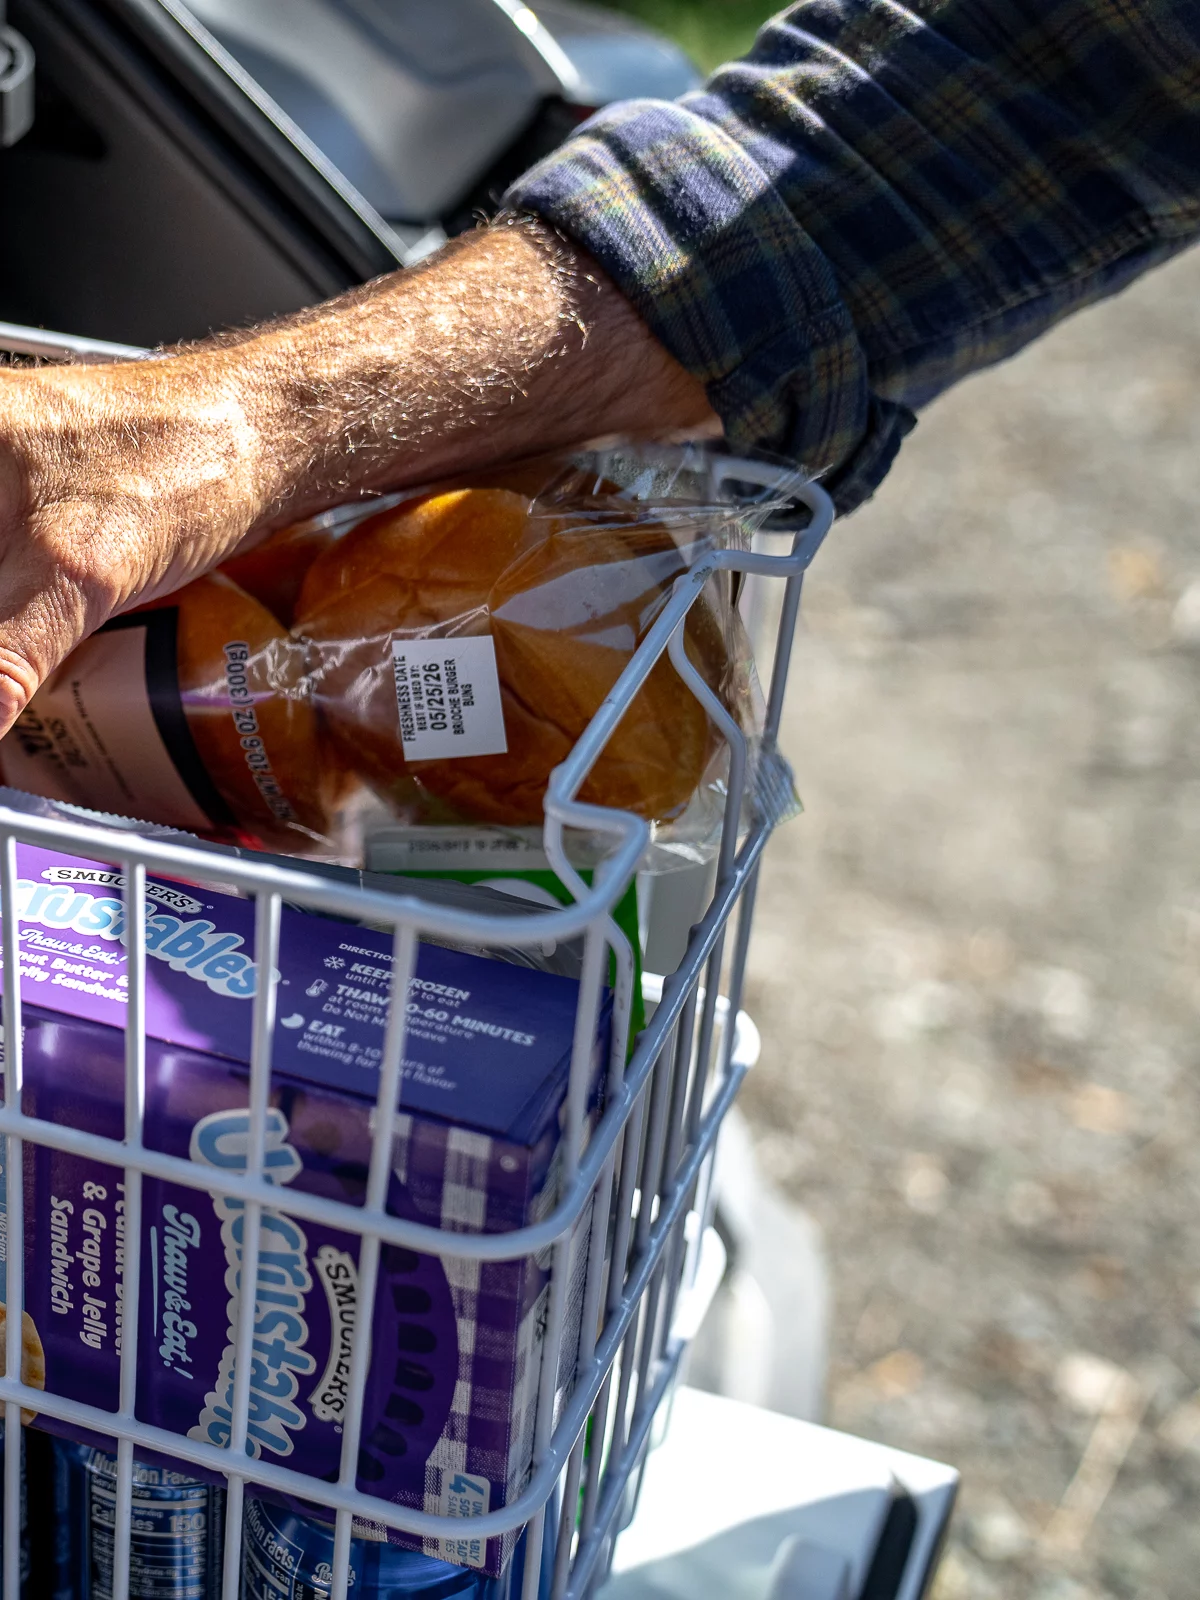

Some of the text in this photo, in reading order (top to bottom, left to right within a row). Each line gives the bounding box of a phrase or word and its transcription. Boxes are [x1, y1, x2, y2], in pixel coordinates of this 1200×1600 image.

[225, 643, 254, 705] (300g)
[394, 655, 416, 742] FRESHNESS DATE
[411, 681, 423, 701] USED
[422, 663, 448, 730] 05/25/26
[444, 659, 465, 735] BRIOCHE BURGER
[461, 684, 475, 706] BUNS
[235, 709, 256, 733] OZ
[415, 712, 428, 731] BEST
[57, 869, 193, 909] SMUCER'S
[338, 942, 400, 964] DIRECTION
[50, 958, 108, 982] Butter
[350, 963, 471, 1001] KEEP ROZEN
[18, 965, 50, 982] elly
[51, 973, 129, 1003] Sandwic
[345, 972, 461, 1009] until rey to eat
[328, 994, 344, 1005] at
[351, 1000, 383, 1015] room
[336, 984, 536, 1047] THAW 0-60 MINUTES
[307, 1019, 347, 1038] EAT
[322, 1003, 448, 1044] Do Not Mowave
[297, 1040, 353, 1065] thawing
[302, 1031, 346, 1051] within
[50, 1195, 75, 1315] Sandwich
[75, 1181, 107, 1350] & Grape Jelly
[91, 1474, 117, 1490] Servi
[449, 1474, 485, 1496] 4
[91, 1503, 206, 1532] Calies 150
[459, 1498, 470, 1518] SOF
[262, 1531, 295, 1570] Facts
[275, 1569, 291, 1586] can
